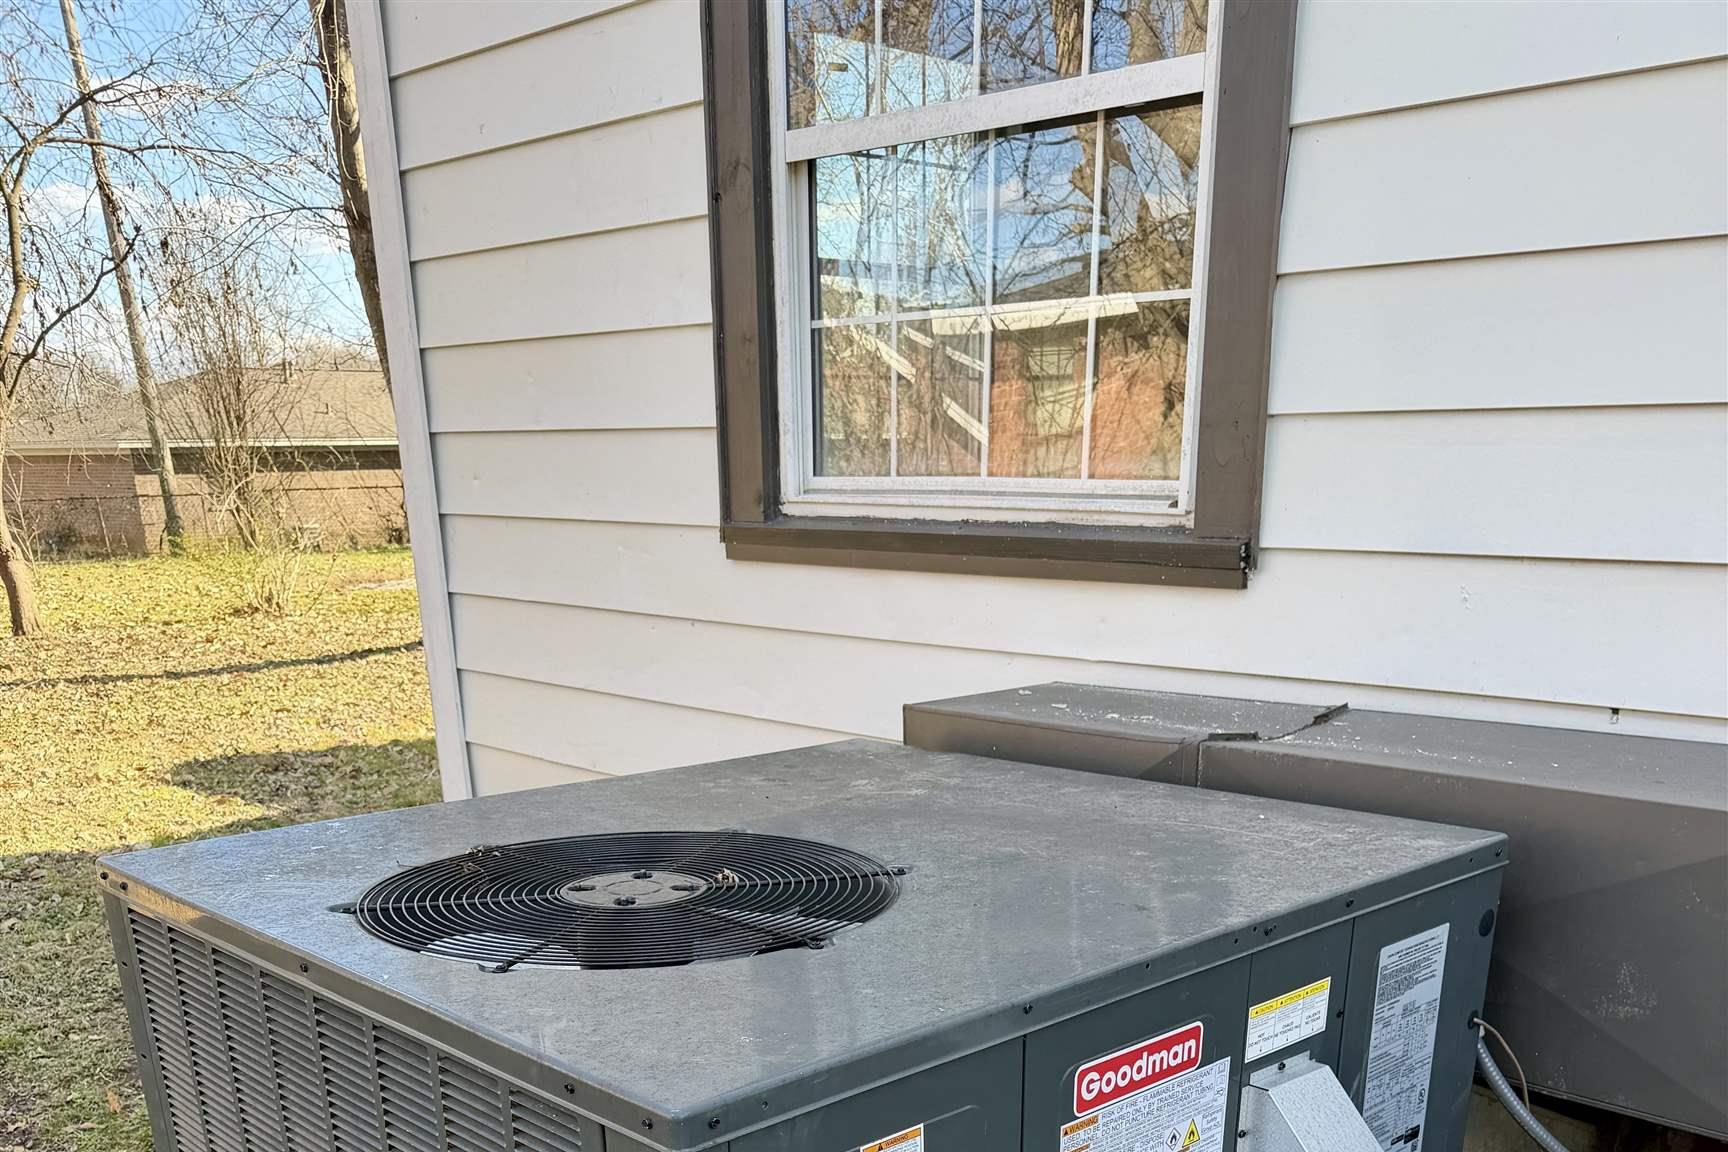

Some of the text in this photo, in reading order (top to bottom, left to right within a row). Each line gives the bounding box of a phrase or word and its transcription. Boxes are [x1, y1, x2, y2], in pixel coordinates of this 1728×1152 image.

[1081, 1038, 1196, 1101] Goodman
[1070, 1116, 1098, 1135] WARNING
[1102, 1109, 1115, 1121] RISK
[1117, 1105, 1124, 1115] OF
[1126, 1099, 1138, 1111] FIRE
[1176, 1068, 1213, 1090] REFRIGERANT
[1102, 1111, 1130, 1130] REPAIRED
[1157, 1090, 1180, 1106] TRAINED
[1180, 1081, 1203, 1097] SERVICE
[1125, 1108, 1155, 1127] PUNCTURE
[1156, 1092, 1194, 1114] REFRIGERANT
[885, 1133, 909, 1148] WARNING
